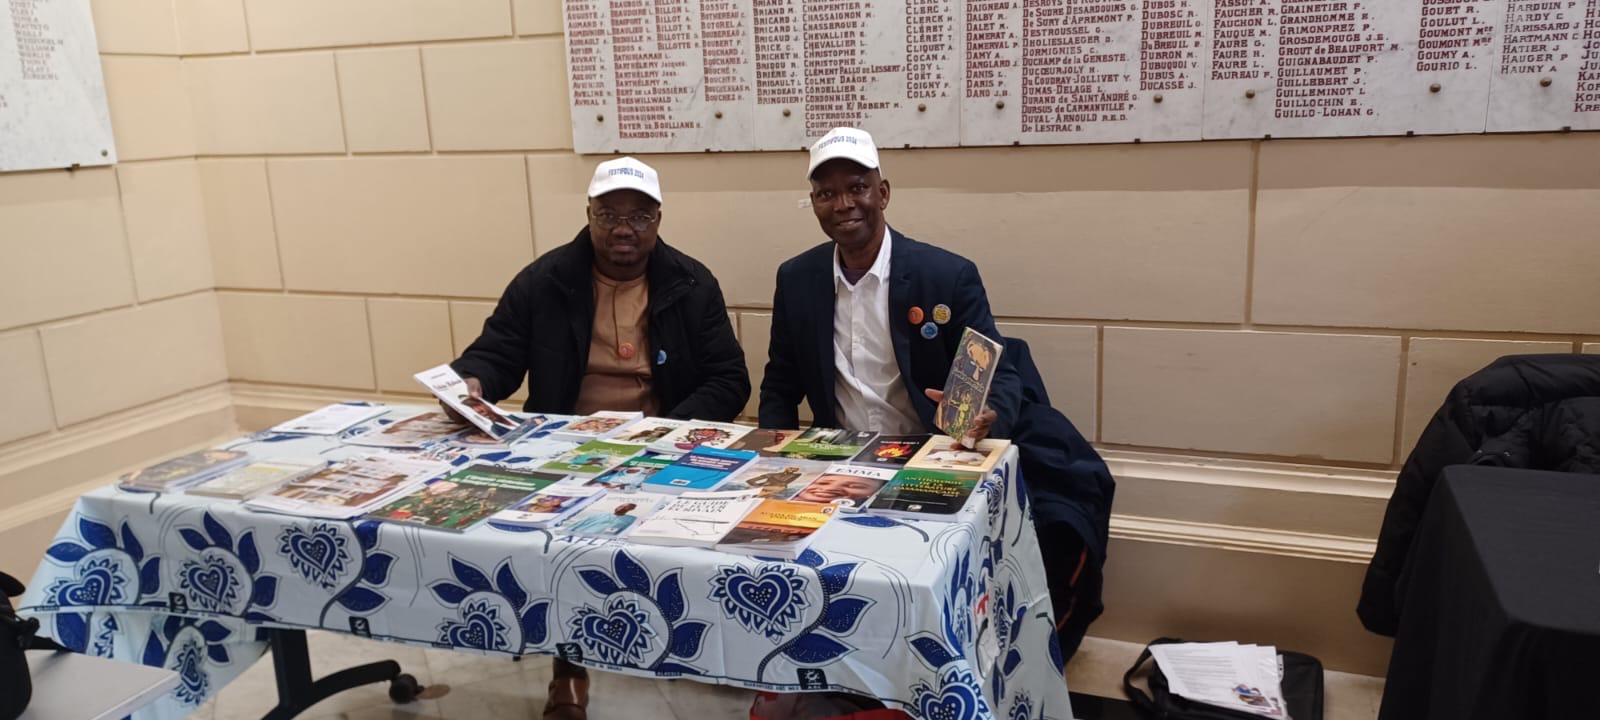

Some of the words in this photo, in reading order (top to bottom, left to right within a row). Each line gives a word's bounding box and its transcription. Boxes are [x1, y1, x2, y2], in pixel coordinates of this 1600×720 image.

[802, 3, 860, 12] CHARPENTIER
[967, 2, 1009, 12] DAIGNEAU
[1143, 1, 1175, 9] DUBOS
[1281, 3, 1347, 14] GRAINETIER
[1507, 2, 1561, 12] HARDUIN
[906, 6, 939, 15] CLERC
[1023, 9, 1033, 17] De
[1142, 10, 1183, 19] DUBOSC
[1215, 8, 1263, 18] FAUCHER
[1422, 6, 1460, 16] GOUET
[906, 16, 943, 24] CLERCK
[967, 13, 993, 21] DALBY
[1280, 13, 1355, 24] GRANDHOMME
[1506, 13, 1550, 22] HARDY
[1023, 19, 1033, 27] De
[1037, 18, 1059, 27] SURY
[1142, 20, 1192, 30] DUBREUIL
[1214, 18, 1261, 28] FAUCHON
[1421, 17, 1467, 27] GOULUT
[967, 23, 995, 31] DALET
[1280, 24, 1355, 35] GRIMONPREZ
[1505, 23, 1569, 33] HARISSARD
[804, 31, 855, 40] CHEVALLIER
[1023, 27, 1089, 37] DESTROUSSEL
[1142, 30, 1191, 40] DUBREUIL
[1214, 29, 1254, 39] FAUQUE
[1420, 28, 1472, 38] GOUMONT
[1504, 33, 1568, 43] HARTMANN
[804, 40, 855, 49] CHEVALLIER
[906, 44, 945, 53] CLIQUET
[1154, 40, 1188, 49] BREUIL
[1213, 40, 1247, 49] FAURE
[1418, 39, 1469, 49] GOUMONT
[804, 49, 855, 58] CHRISTOPHE
[1023, 47, 1082, 56] DORMIGNIES
[1279, 47, 1312, 55] GROUT
[1315, 46, 1325, 54] de
[1328, 44, 1384, 53] BEAUFORT
[1503, 45, 1546, 53] HATIER
[906, 54, 937, 62] COCAN
[967, 51, 991, 59] DAMY
[1141, 51, 1181, 60] DUBRON
[1213, 50, 1247, 59] FAURE
[1418, 51, 1458, 60] GOUMY
[1502, 54, 1553, 63] HAUGER
[804, 58, 855, 67] CHRISTOPHE
[1023, 57, 1061, 66] DUCHAMP
[1141, 61, 1187, 70] DUBUQUOI
[1212, 61, 1247, 69] FAURE
[1278, 56, 1360, 66] GUIGNABAUDET
[907, 63, 932, 71] CODY
[1417, 62, 1459, 71] GOURIO
[1501, 65, 1543, 74] HAUNY
[1140, 71, 1175, 80] DUBUS
[1212, 71, 1259, 80] FAUREAU
[1278, 67, 1347, 77] GUILLAUMET
[1140, 81, 1184, 90] DUCASSE
[1277, 78, 1348, 87] GUILLEBERT
[1276, 88, 1353, 97] GUILLEMINOT
[1023, 96, 1055, 104] DURAND
[1276, 99, 1343, 107] GUILLOCHIN
[1022, 105, 1052, 114] DURSUS
[1067, 103, 1124, 112] CARMANVILLE
[835, 468, 881, 477] EMMA
